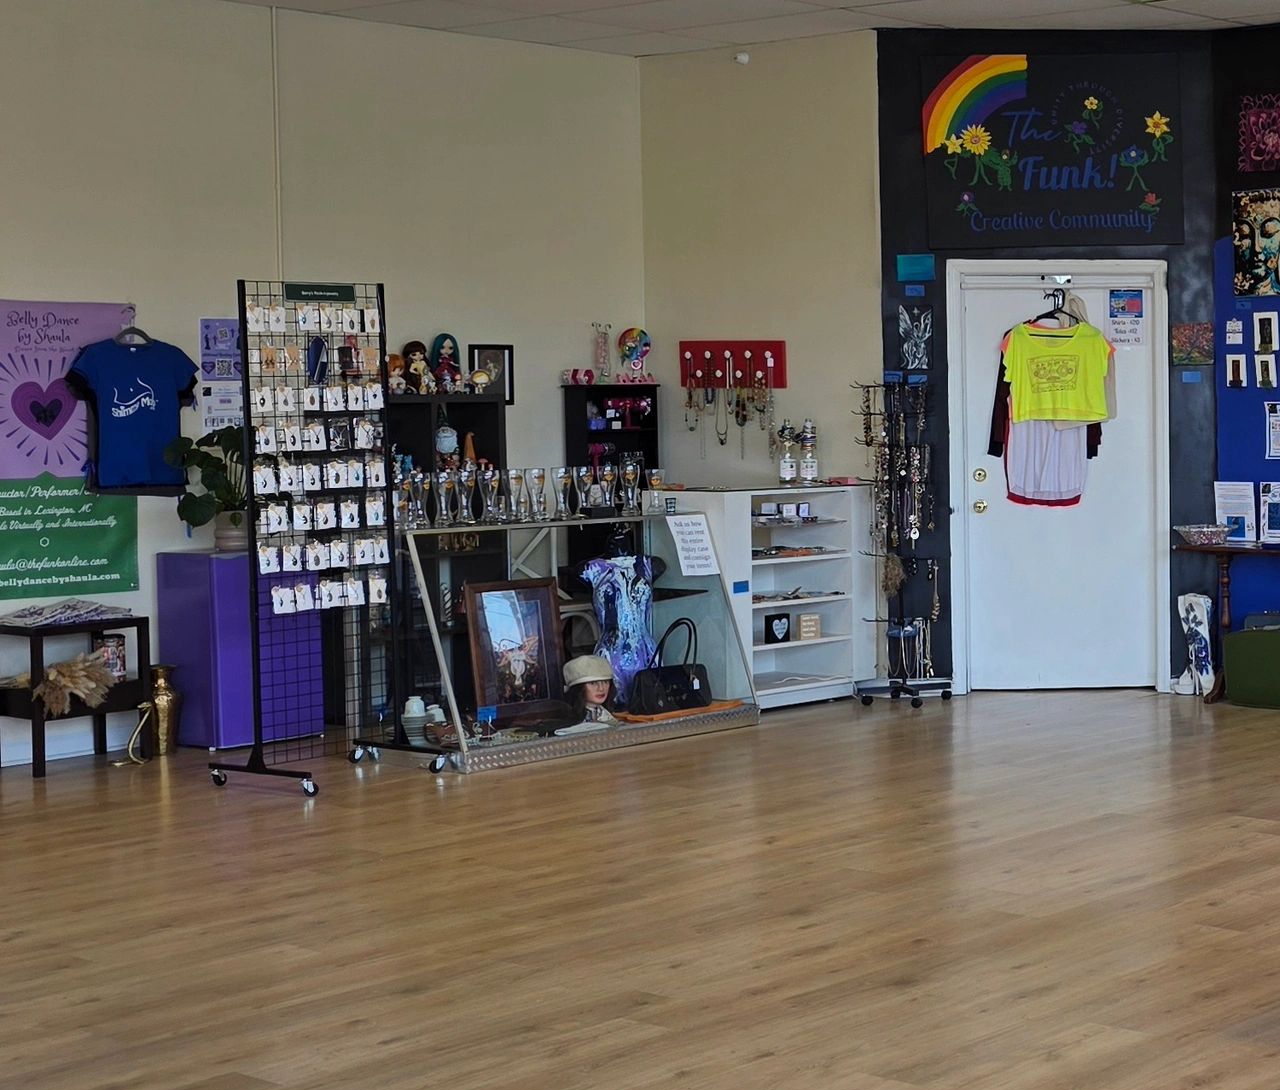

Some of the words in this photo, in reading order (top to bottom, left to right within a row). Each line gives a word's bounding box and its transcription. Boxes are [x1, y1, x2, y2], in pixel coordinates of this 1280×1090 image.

[1000, 107, 1064, 148] The
[1018, 153, 1119, 192] Funk!
[970, 210, 1044, 233] Creative
[1049, 208, 1156, 233] Community
[6, 310, 38, 329] Belly
[41, 311, 80, 329] Dance
[17, 327, 31, 345] by
[33, 327, 71, 345] Shaula
[23, 507, 33, 516] in
[78, 502, 93, 513] NC
[9, 519, 44, 531] Virtually
[45, 518, 61, 529] and
[62, 515, 118, 528] Internationally
